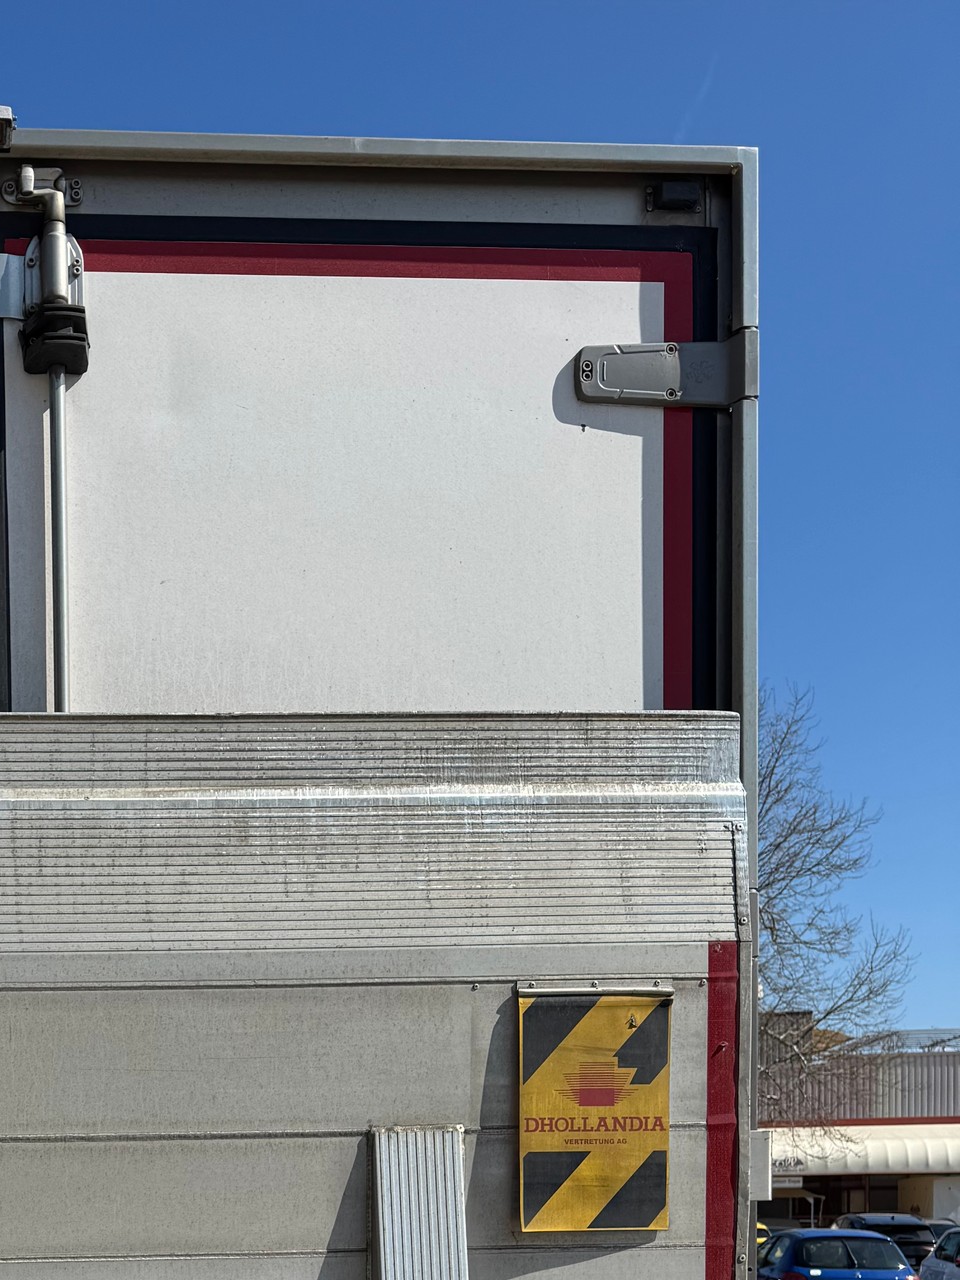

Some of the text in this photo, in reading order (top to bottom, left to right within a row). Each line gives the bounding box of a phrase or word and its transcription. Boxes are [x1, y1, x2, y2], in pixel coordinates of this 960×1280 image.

[524, 1116, 667, 1133] DHOLLANDIA
[564, 1137, 628, 1146] VERTRETUNG AG
